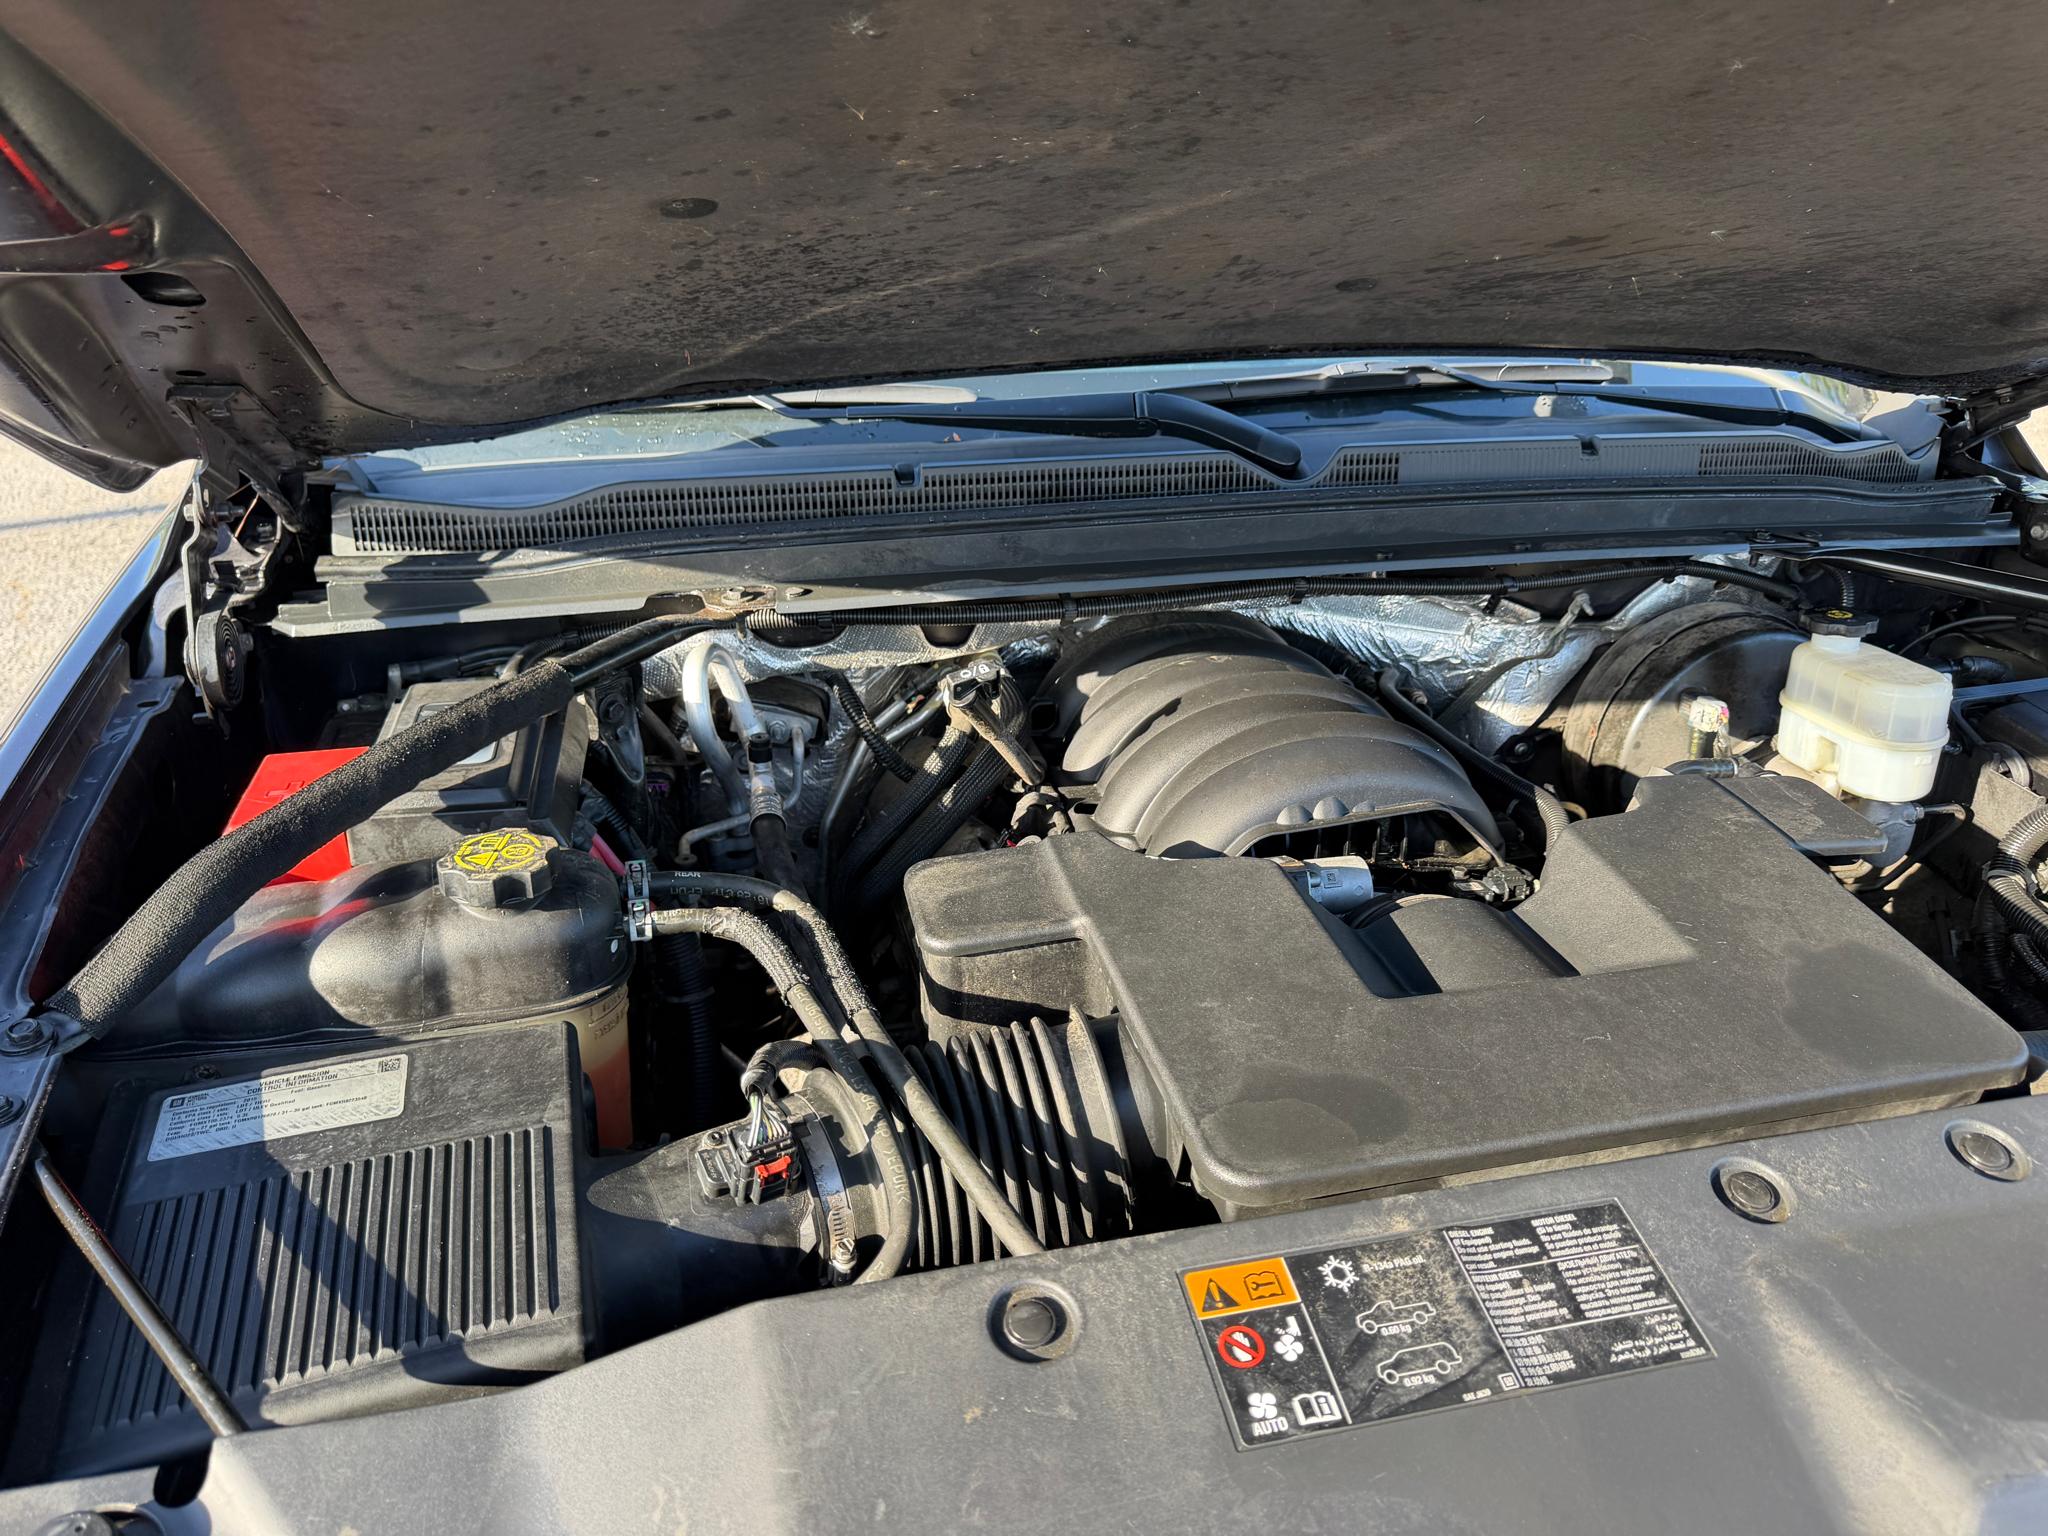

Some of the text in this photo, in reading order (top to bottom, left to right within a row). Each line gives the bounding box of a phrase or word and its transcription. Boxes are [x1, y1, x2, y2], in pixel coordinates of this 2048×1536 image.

[247, 1073, 337, 1094] CONTROL INFORMATION
[259, 1069, 329, 1086] VEHICLE EMISSION
[1529, 1212, 1577, 1227] MOTOR DIESEL
[1447, 1226, 1495, 1239] DIESEL ENGINE
[1487, 1240, 1514, 1252] starting
[1553, 1238, 1579, 1249] pueden
[1576, 1234, 1604, 1245] producir
[1513, 1244, 1541, 1256] damage
[1393, 1255, 1413, 1267] PAG
[1470, 1269, 1523, 1284] MOTEUR DIESEL
[1603, 1287, 1621, 1296] Это
[1381, 1324, 1412, 1336] 0.60 kg
[1403, 1374, 1436, 1387] 0.92 kg
[1251, 1416, 1289, 1437] AUTO
